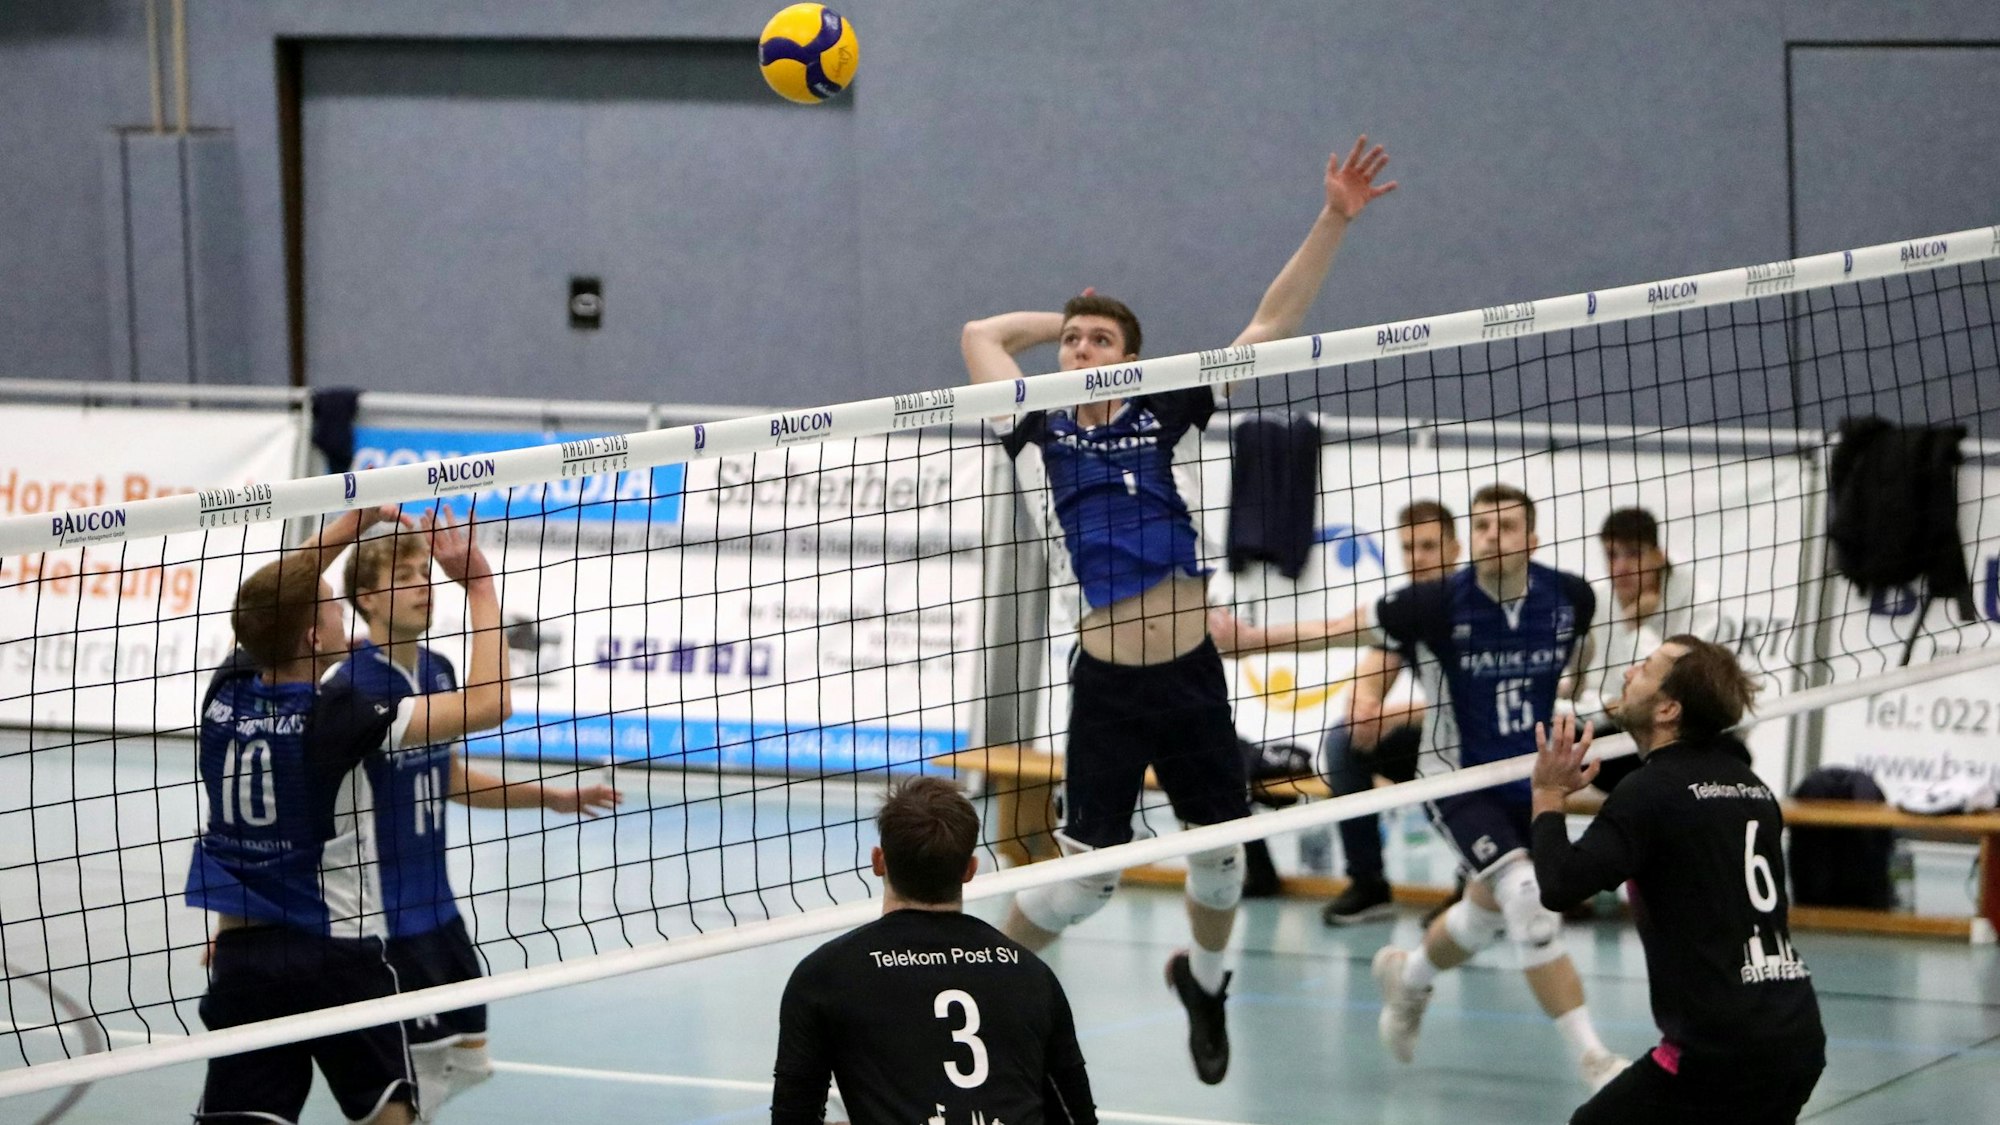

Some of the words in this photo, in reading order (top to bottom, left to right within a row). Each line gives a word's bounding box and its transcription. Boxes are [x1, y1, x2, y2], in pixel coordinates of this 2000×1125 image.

[1901, 241, 1947, 267] BAUCON
[1648, 281, 1698, 310] BAUCON
[1377, 324, 1430, 353] BAUCON
[1085, 367, 1142, 398] BAUCON
[894, 389, 954, 410] RHEIN-SIEG
[771, 412, 832, 445] BAUCON
[893, 409, 953, 428] VOLLEYS
[560, 435, 628, 459] RHEIN-SIEG
[427, 460, 495, 494] BAUCON
[561, 457, 628, 477] VOLLEYS
[199, 483, 272, 508] RHEIN-SIEG
[52, 509, 126, 545] BAUCON
[199, 508, 272, 528] VOLLEYS
[1496, 678, 1534, 736] 15
[1931, 697, 2000, 735] 022
[222, 739, 277, 827] 10
[1687, 781, 1740, 800] Telekom
[1744, 819, 1778, 913] 6
[870, 949, 947, 968] Telekom
[951, 947, 993, 964] Post
[995, 946, 1019, 965] SV
[933, 988, 989, 1089] 3
